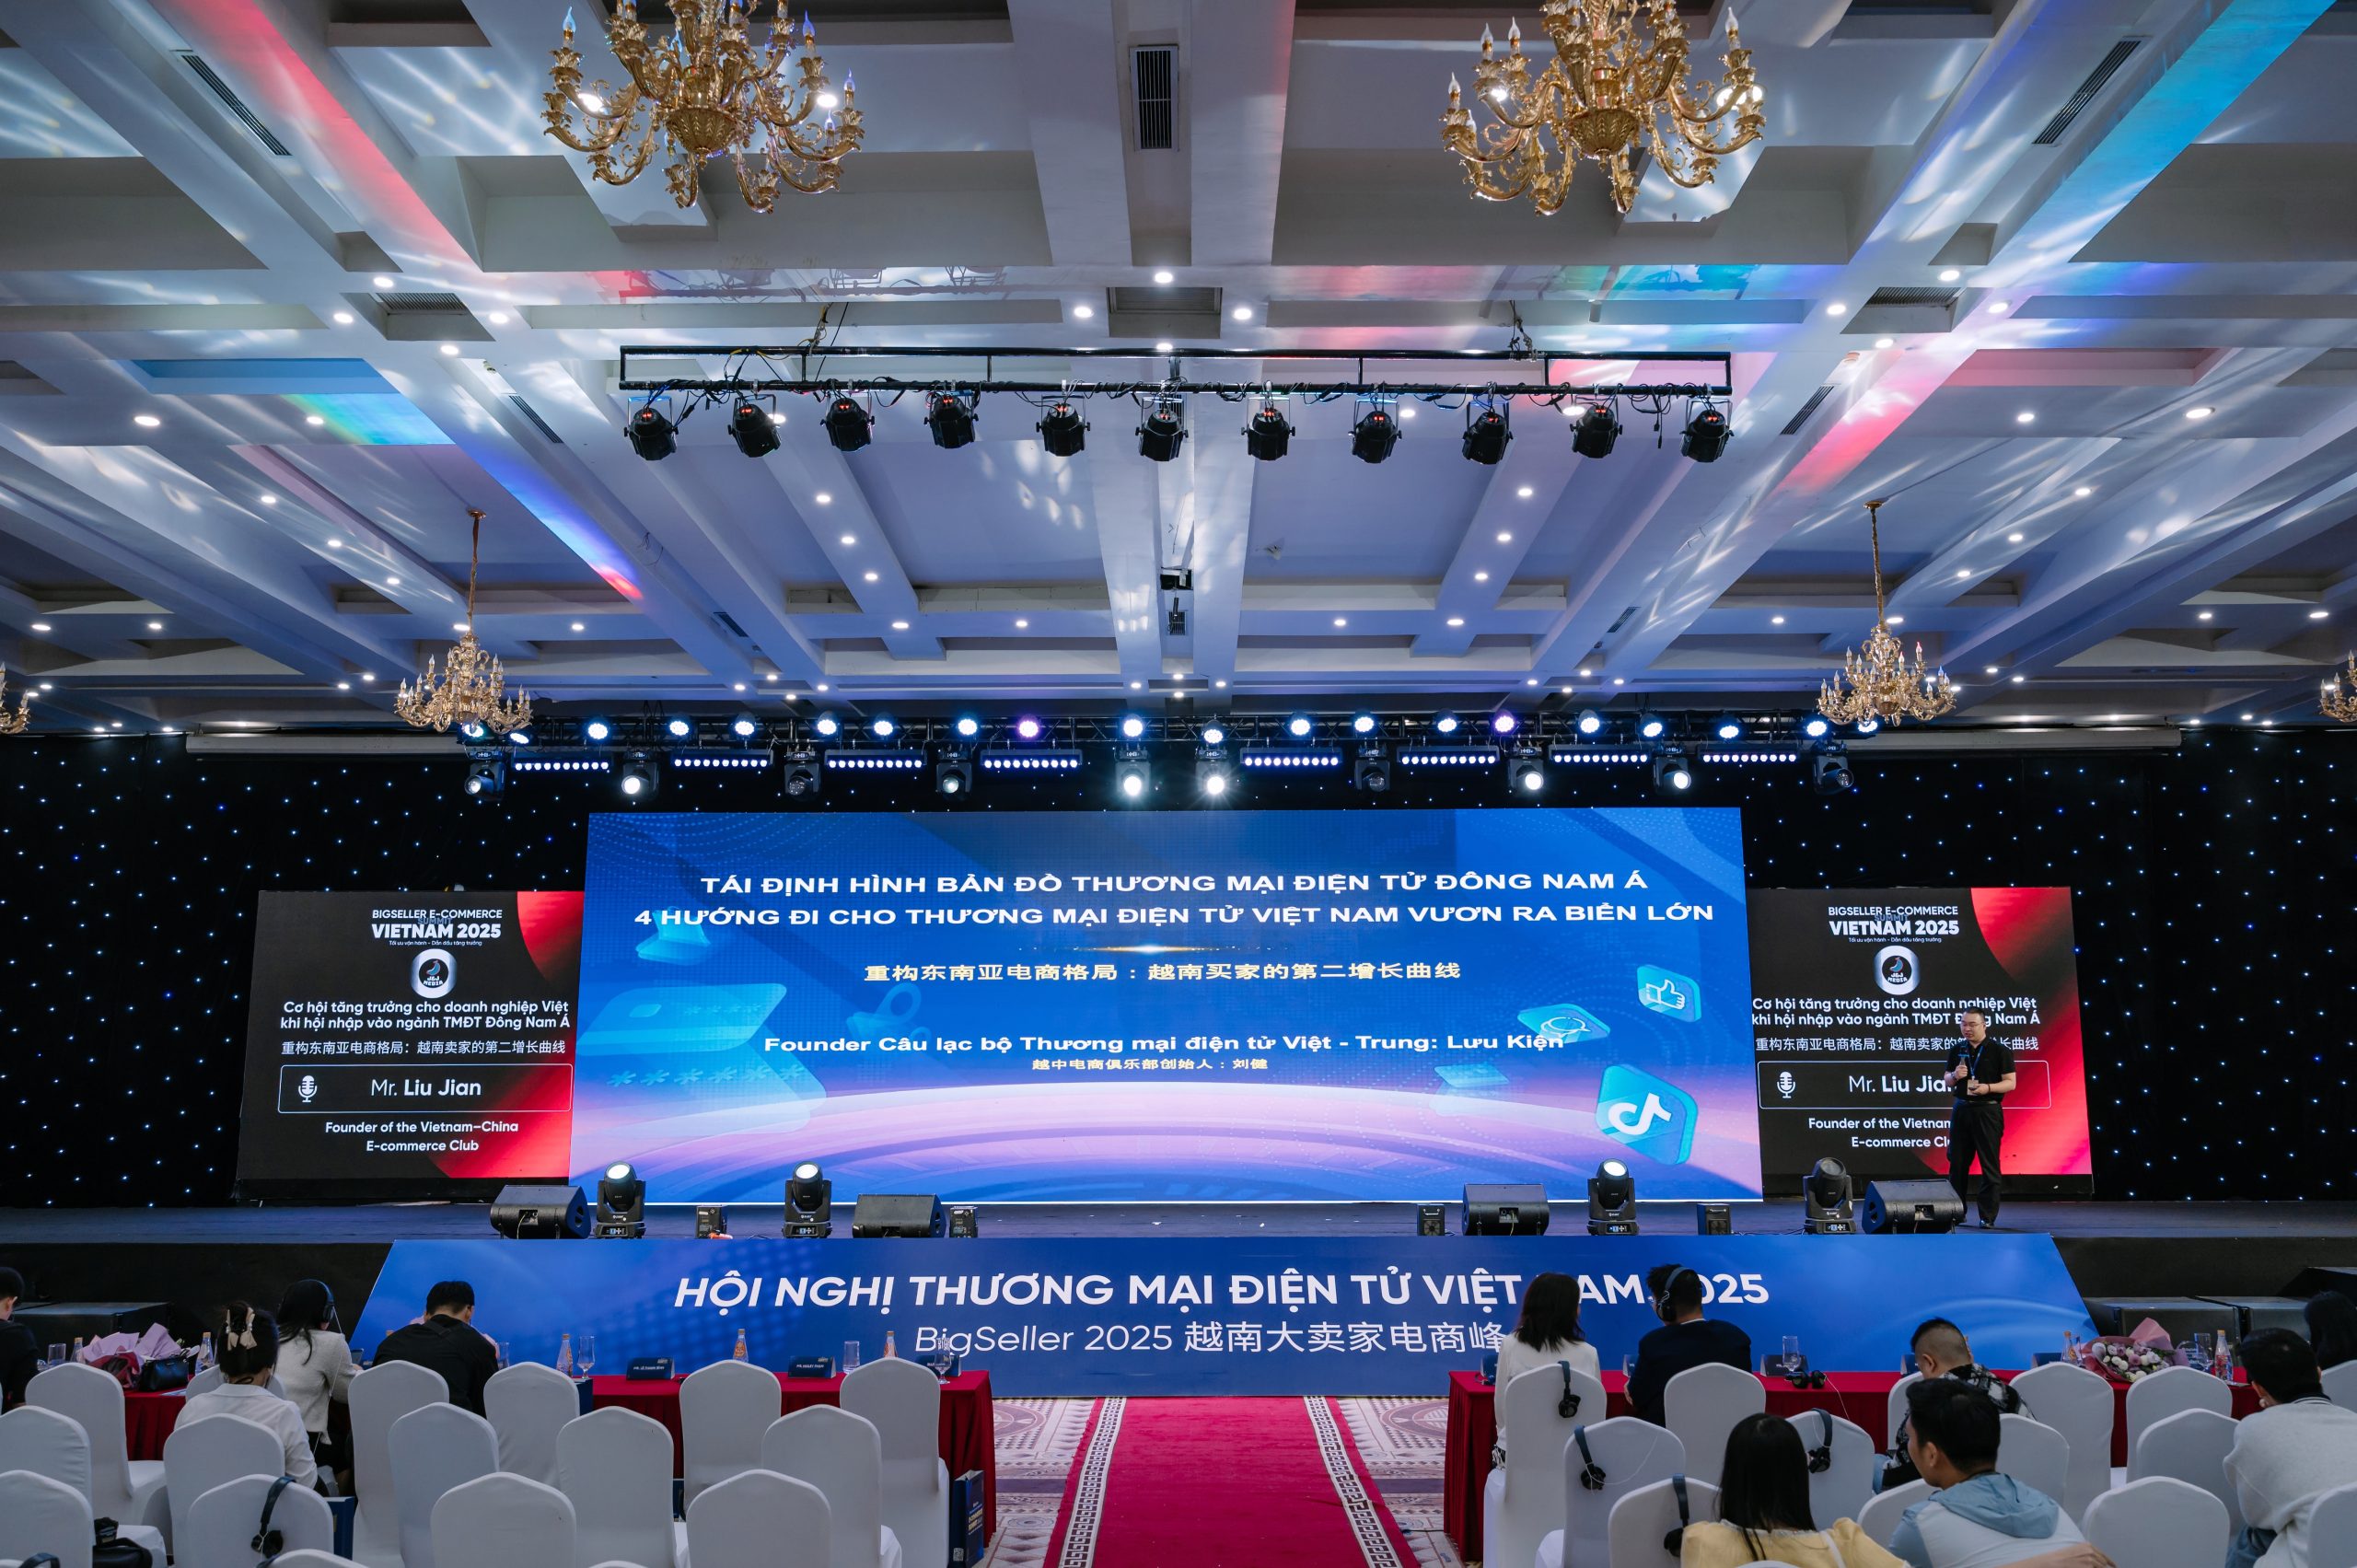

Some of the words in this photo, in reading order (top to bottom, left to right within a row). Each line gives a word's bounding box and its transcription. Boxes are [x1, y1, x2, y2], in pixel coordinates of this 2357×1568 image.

[700, 875, 751, 893] TÁI
[761, 877, 839, 897] ĐỊNH
[850, 874, 926, 893] HÌNH
[937, 873, 1004, 892] BẢN
[1013, 873, 1062, 892] ĐỒ
[1071, 876, 1215, 892] THƯƠNG
[1227, 876, 1284, 895] MẠI
[1293, 874, 1369, 894] ĐIỆN
[1379, 871, 1427, 890] TỬ
[1434, 871, 1532, 890] ĐÔNG
[1543, 873, 1614, 889] NAM
[1624, 869, 1648, 889] Á
[372, 909, 428, 920] BIGSELLER
[429, 909, 504, 919] E-COMMERCE
[634, 910, 652, 925] 4
[661, 906, 780, 925] HƯỚNG
[788, 910, 819, 925] ĐI
[829, 909, 897, 925] CHO
[905, 908, 1043, 924] THƯƠNG
[1052, 908, 1108, 927] MẠI
[1116, 907, 1189, 927] ĐIỆN
[1199, 904, 1245, 923] TỬ
[1251, 906, 1321, 926] VIỆT
[1330, 907, 1399, 923] NAM
[1407, 906, 1502, 922] VƯƠN
[1513, 906, 1557, 922] RA
[1565, 902, 1637, 921] BIỂN
[1647, 901, 1713, 921] LỚN
[1828, 906, 1883, 916] BIGSELLER
[1885, 905, 1959, 916] E-COMMERCE
[371, 923, 454, 938] VIETNAM
[457, 923, 502, 939] 2025
[1829, 920, 1911, 935] VIETNAM
[1914, 920, 1960, 935] 2025
[283, 1001, 304, 1014] Cơ
[307, 1001, 327, 1017] hội
[331, 1001, 364, 1016] tăng
[366, 1000, 412, 1016] trưởng
[415, 1000, 441, 1013] cho
[444, 1000, 488, 1013] doanh
[491, 1000, 539, 1016] nghiệp
[541, 999, 569, 1016] Việt
[1752, 997, 1772, 1010] Cơ
[1775, 997, 1796, 1013] hội
[1798, 997, 1831, 1013] tăng
[1834, 996, 1880, 1013] trưởng
[1883, 997, 1909, 1010] cho
[1911, 997, 1956, 1009] doanh
[2008, 996, 2038, 1012] Việt
[280, 1016, 301, 1029] khi
[303, 1016, 325, 1032] hội
[328, 1016, 364, 1032] nhập
[366, 1016, 393, 1028] vào
[395, 1016, 440, 1032] ngành
[443, 1016, 482, 1028] TMĐT
[484, 1015, 522, 1031] Đông
[525, 1015, 557, 1028] Nam
[559, 1013, 571, 1028] Á
[1751, 1013, 1771, 1026] khi
[1774, 1013, 1795, 1028] hội
[1798, 1013, 1834, 1028] nhập
[1836, 1013, 1863, 1026] vào
[1865, 1013, 1910, 1028] ngành
[1911, 1013, 1952, 1025] TMĐT
[1994, 1013, 2027, 1025] Nam
[2029, 1009, 2041, 1025] Á
[765, 1038, 871, 1051] Founder
[878, 1037, 927, 1051] Câu
[936, 1037, 972, 1054] lạc
[981, 1037, 1013, 1053] bộ
[1019, 1037, 1123, 1053] Thương
[1132, 1036, 1176, 1053] mại
[1185, 1036, 1239, 1053] điện
[1247, 1036, 1276, 1050] tử
[1283, 1035, 1331, 1052] Việt
[1354, 1035, 1437, 1052] Trung:
[1447, 1035, 1498, 1049] Lưu
[1507, 1034, 1564, 1051] Kiện
[371, 1078, 398, 1097] Mr.
[403, 1078, 433, 1097] Liu
[437, 1078, 482, 1097] Jian
[1849, 1075, 1876, 1093] Mr.
[1881, 1075, 1910, 1093] Liu
[1915, 1074, 1952, 1093] Jia
[325, 1121, 378, 1133] Founder
[380, 1121, 394, 1132] of
[396, 1121, 418, 1132] the
[1808, 1117, 1861, 1129] Founder
[1863, 1117, 1876, 1129] of
[1877, 1117, 1899, 1129] the
[366, 1140, 447, 1152] E-commerce
[448, 1139, 480, 1151] Club
[1851, 1136, 1932, 1148] E-commerce
[674, 1270, 762, 1316] HỘI
[774, 1276, 895, 1315] NGHỊ
[909, 1272, 1114, 1306] THƯƠNG
[1129, 1275, 1213, 1313] MẠI
[1228, 1268, 1338, 1313] ĐIỆN
[1350, 1265, 1412, 1305] TỬ
[1422, 1267, 1522, 1313] VIỆT
[1577, 1273, 1645, 1305] AM
[915, 1325, 1074, 1358] BigSeller
[1085, 1325, 1173, 1351] 2025
